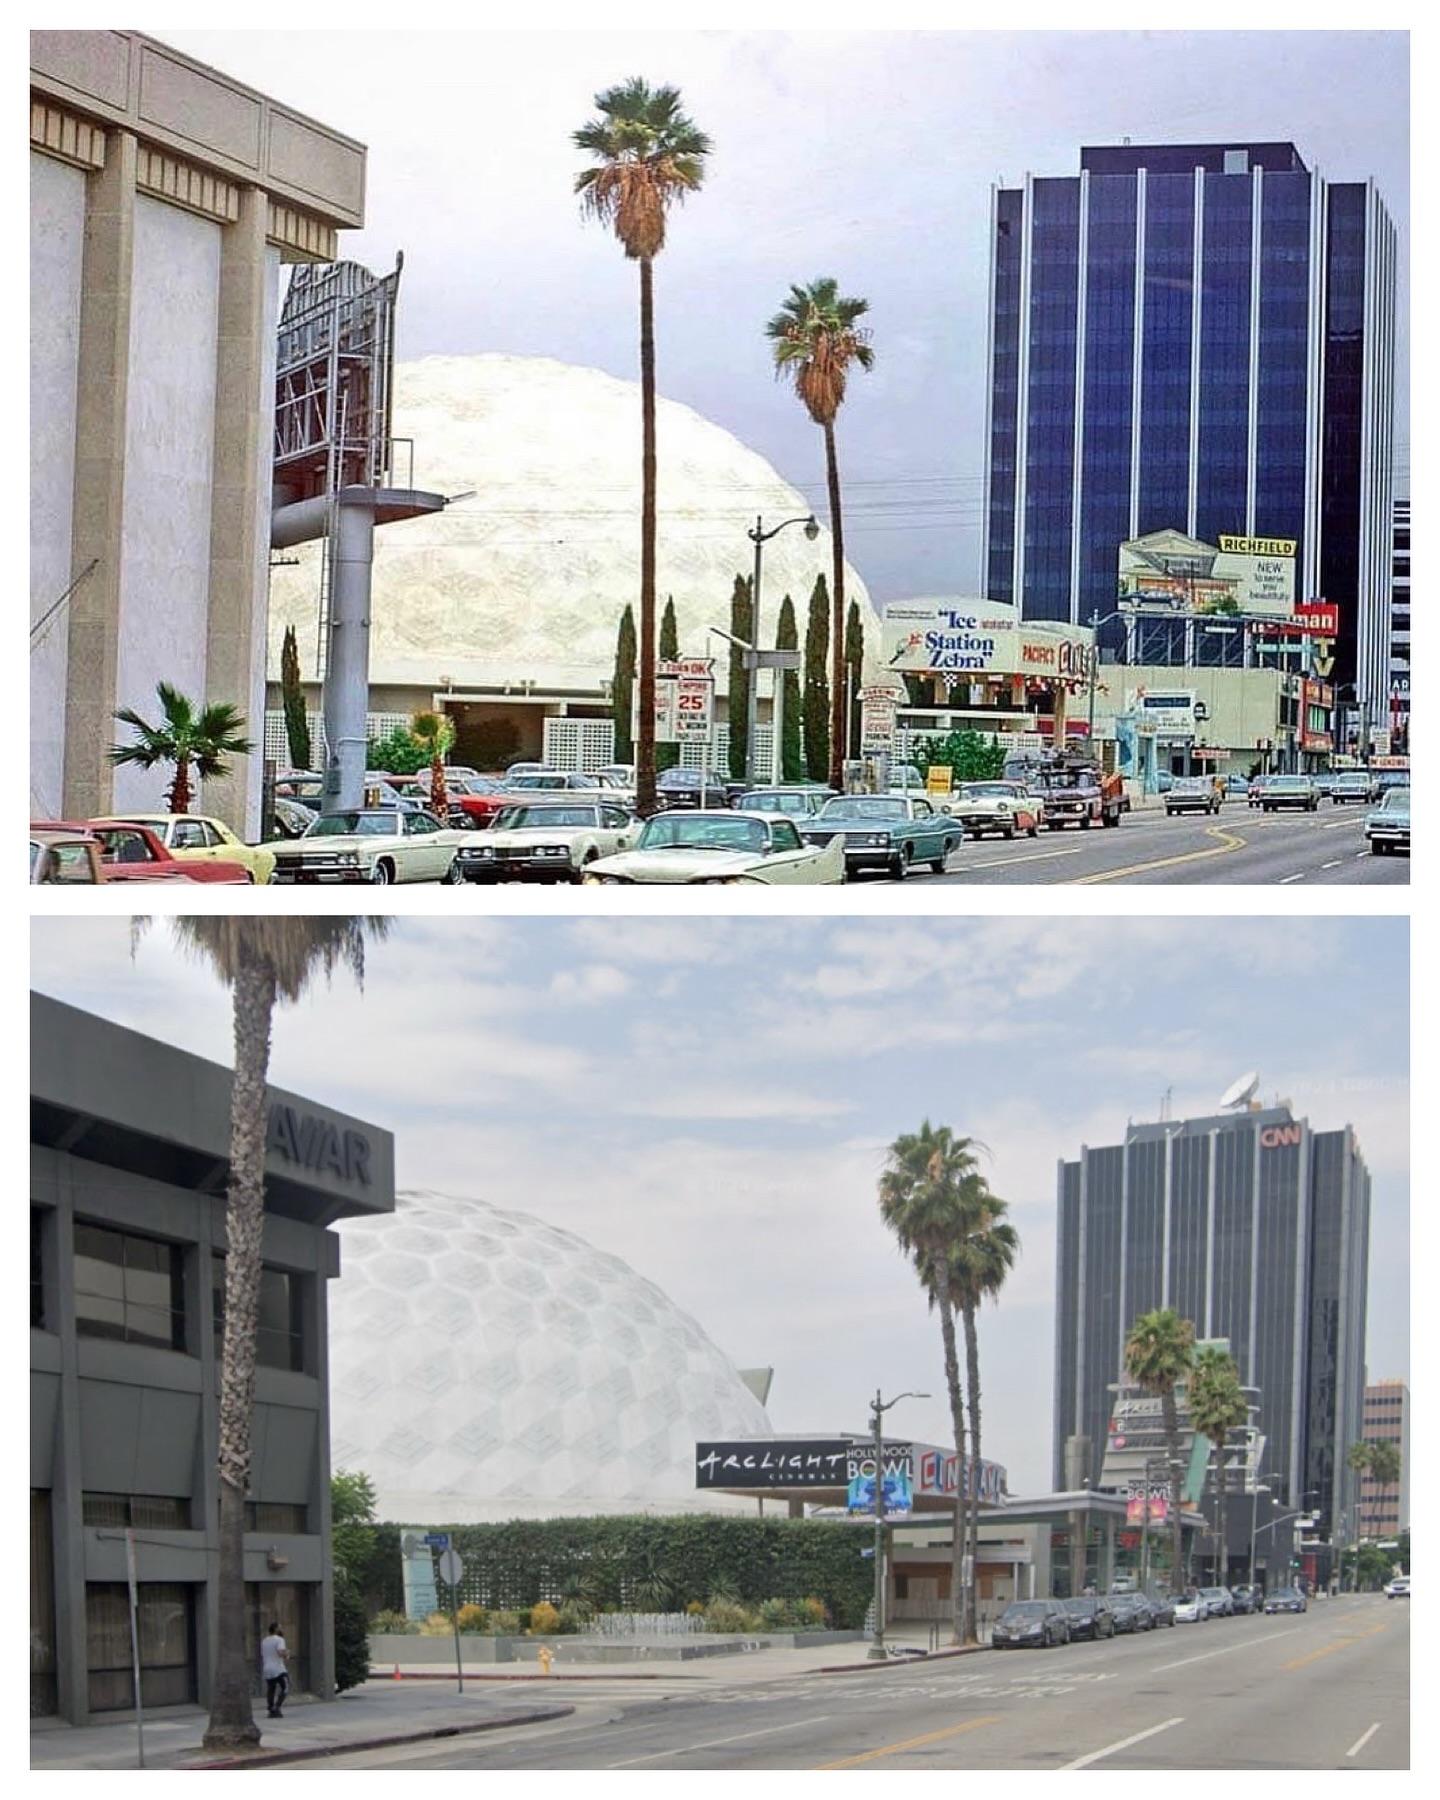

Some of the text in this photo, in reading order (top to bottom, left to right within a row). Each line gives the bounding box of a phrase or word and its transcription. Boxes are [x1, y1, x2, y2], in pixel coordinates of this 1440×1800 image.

[1224, 537, 1293, 553] RICHFIELD
[1257, 562, 1282, 573] NEW
[924, 630, 995, 650] Station
[679, 694, 703, 710] 25
[1260, 1126, 1301, 1148] CNN
[769, 1473, 837, 1481] CINEMAS
[847, 1458, 914, 1480] BOWL
